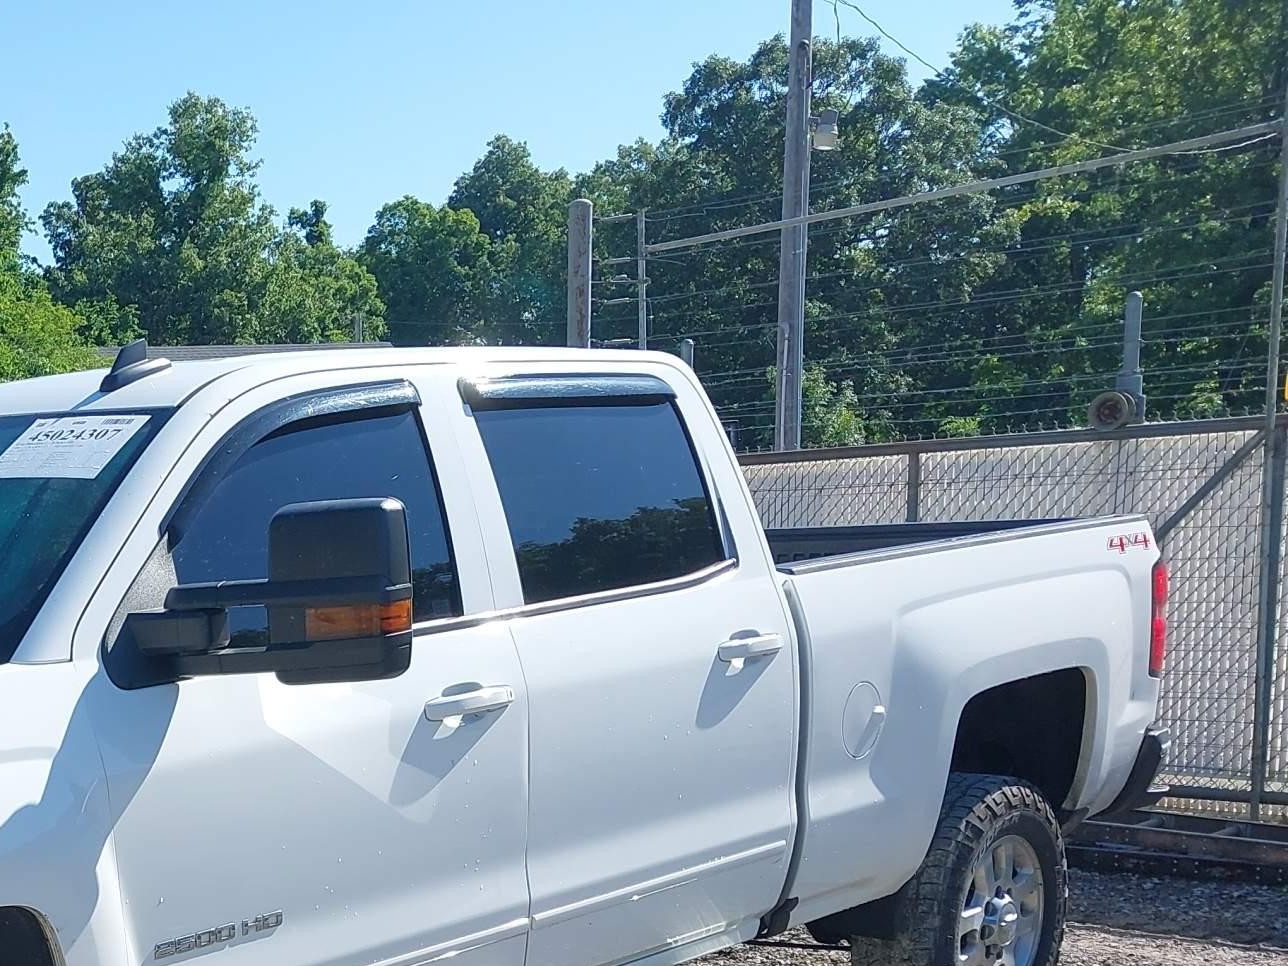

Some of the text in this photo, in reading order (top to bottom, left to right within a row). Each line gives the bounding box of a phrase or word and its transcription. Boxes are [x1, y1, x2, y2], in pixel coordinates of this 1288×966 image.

[28, 428, 123, 442] 45024307
[154, 909, 283, 960] 2500 HD
